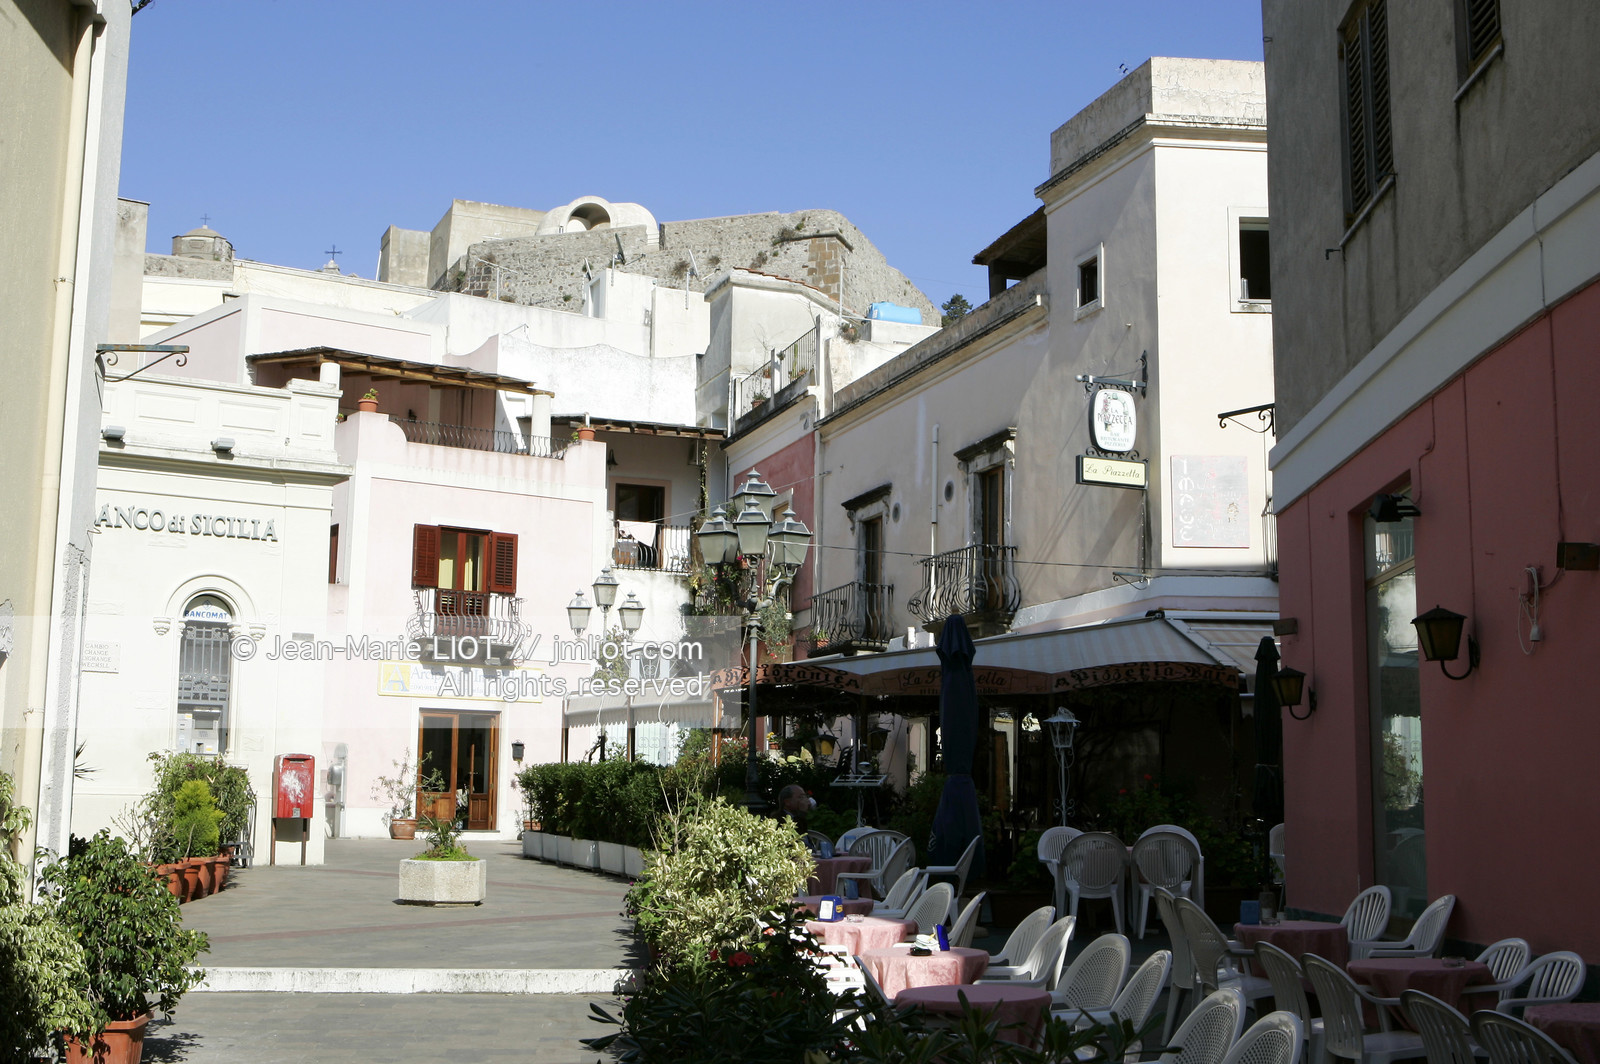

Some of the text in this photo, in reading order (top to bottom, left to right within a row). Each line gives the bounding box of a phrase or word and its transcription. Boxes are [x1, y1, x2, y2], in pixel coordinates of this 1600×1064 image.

[1085, 462, 1140, 479] La Piazzetta
[95, 503, 278, 543] ANCO di SICILIA
[185, 610, 227, 619] BANCOMAT
[724, 667, 845, 685] Ritorante
[903, 669, 1006, 686] La Petta
